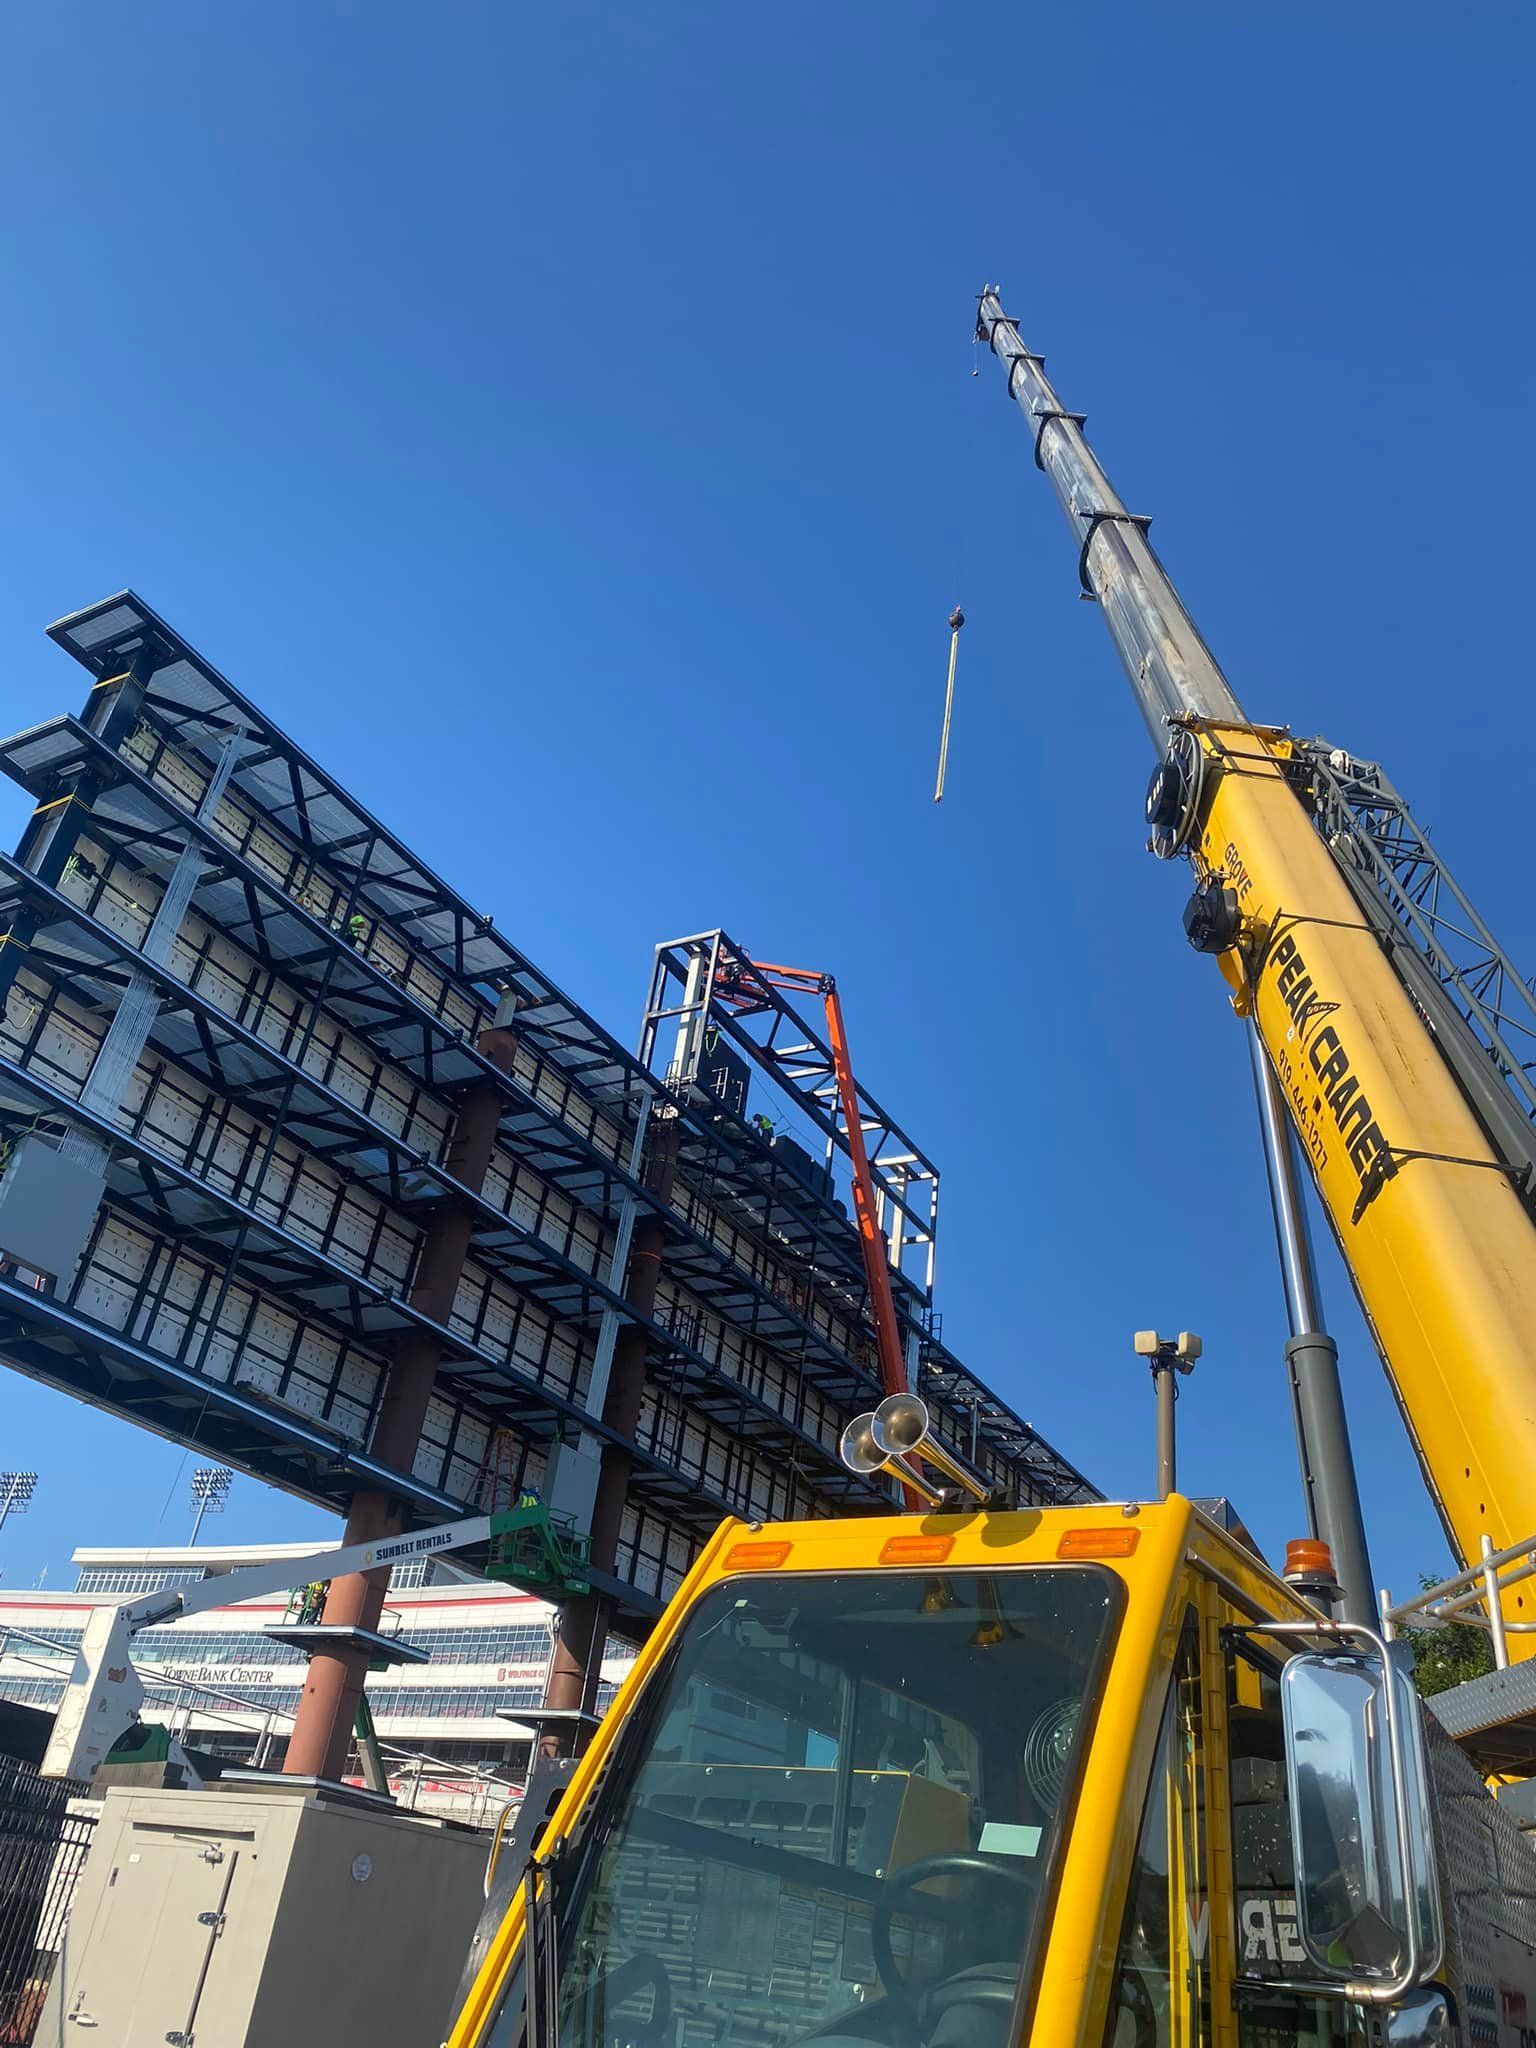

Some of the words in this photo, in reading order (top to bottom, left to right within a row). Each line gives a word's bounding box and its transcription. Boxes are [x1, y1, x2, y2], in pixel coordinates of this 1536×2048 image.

[1225, 842, 1253, 901] GROVE
[1270, 934, 1325, 1042] PEAK
[1279, 1048, 1328, 1172] 919-446-1277
[376, 1542, 415, 1560] SUNBELT
[416, 1533, 452, 1551] RENTALS
